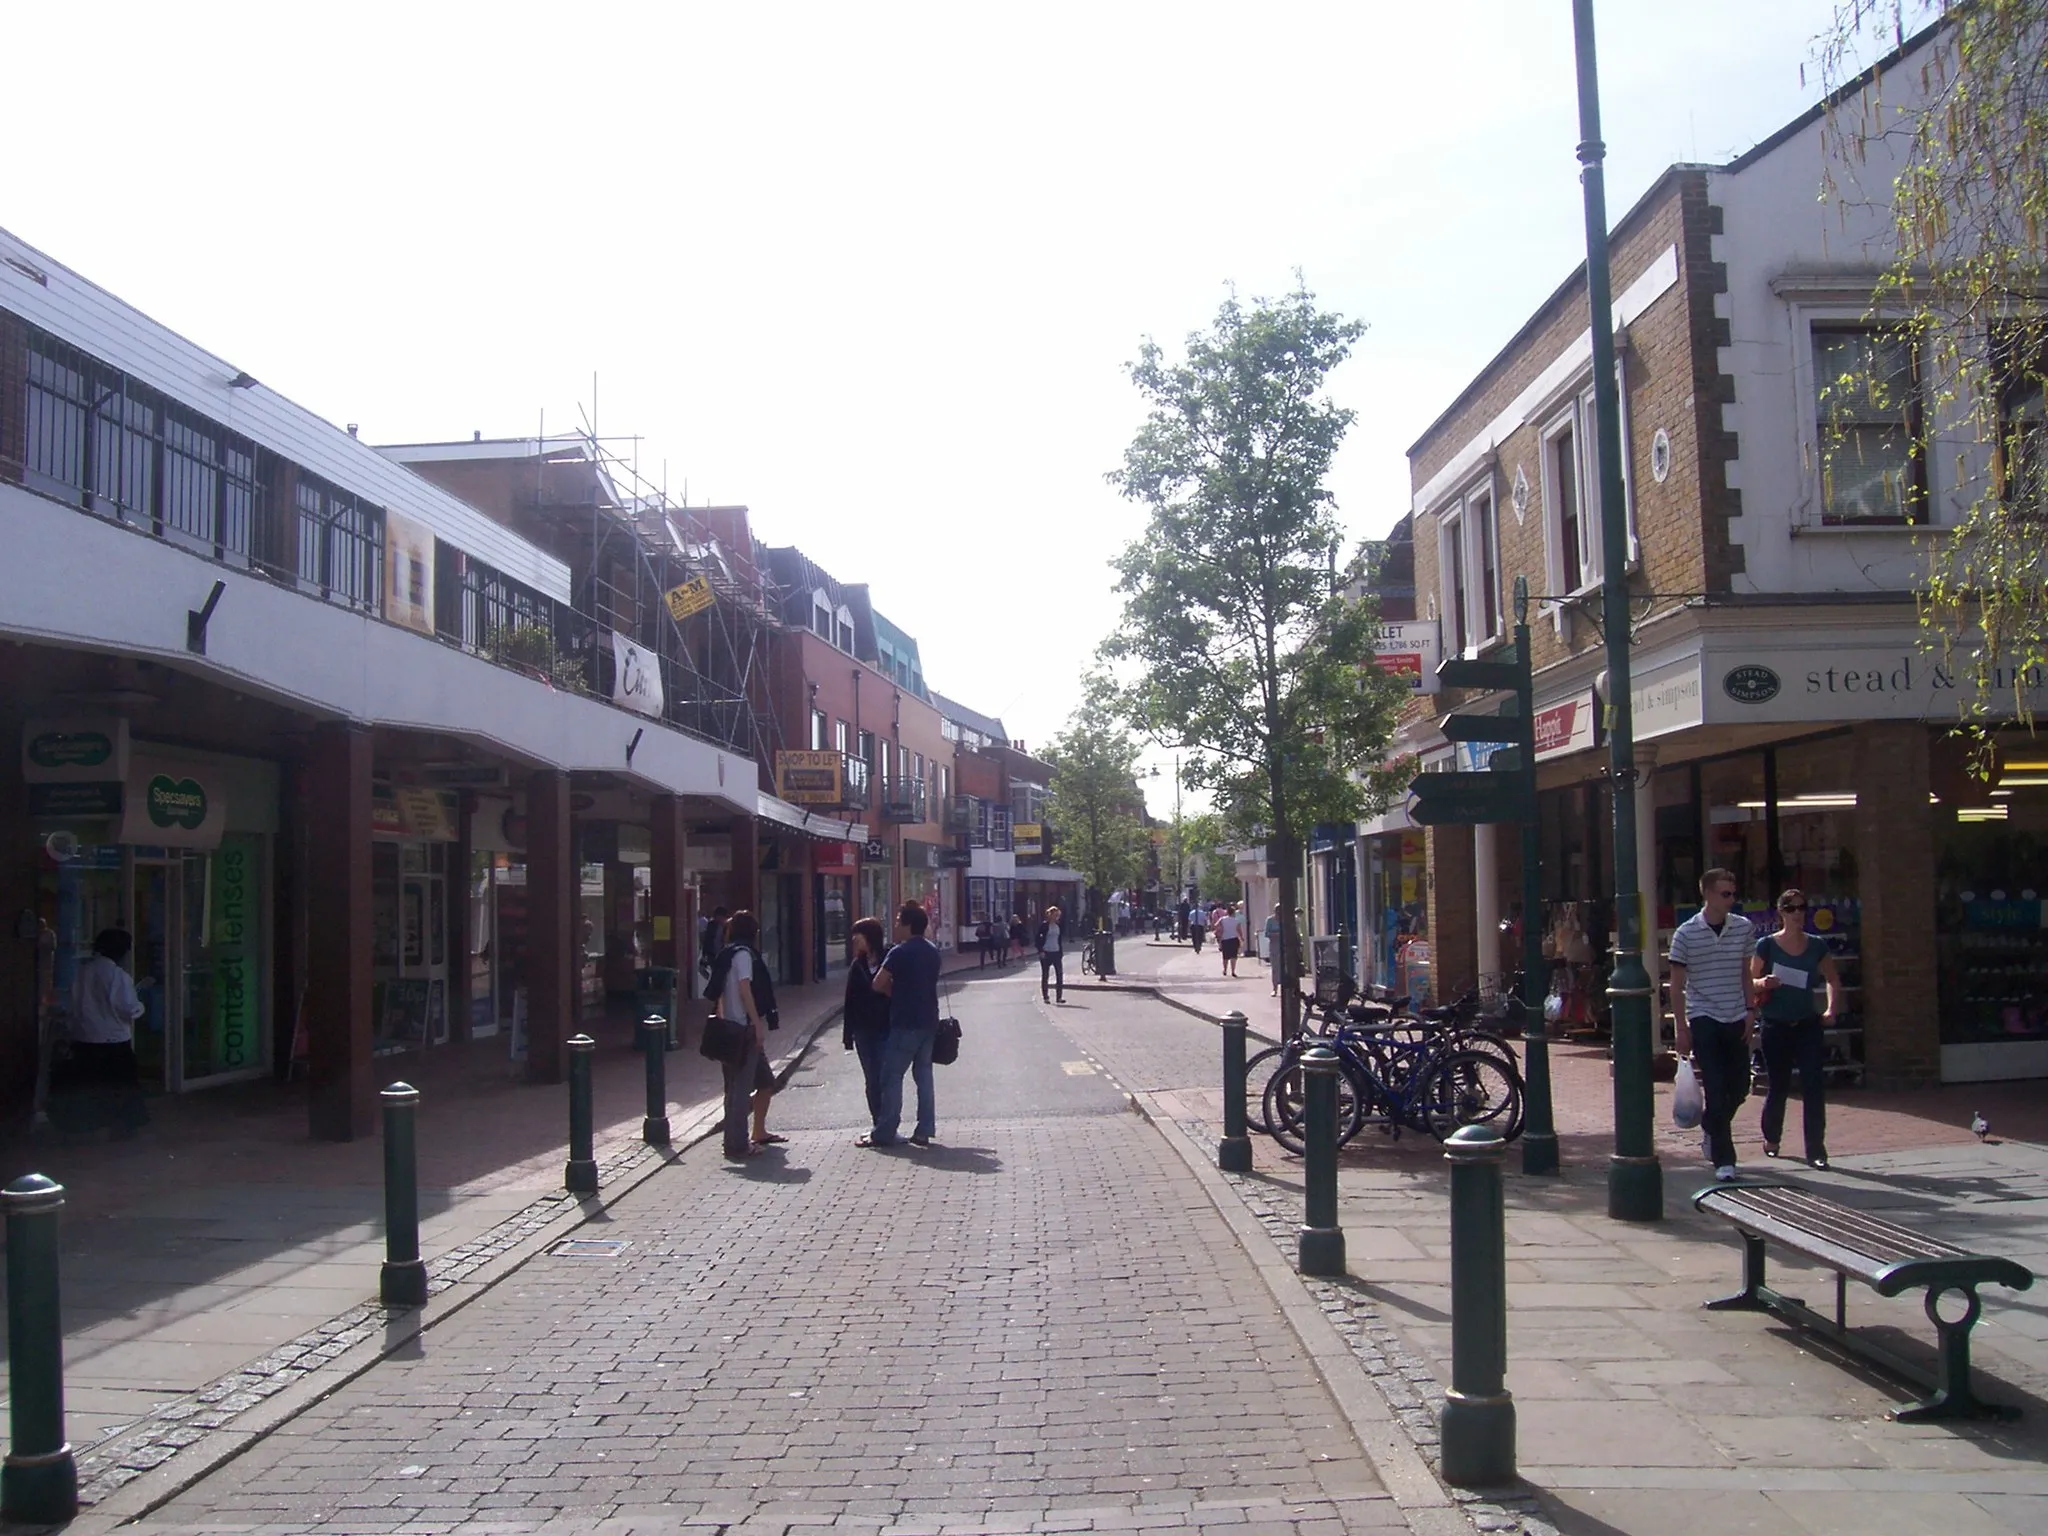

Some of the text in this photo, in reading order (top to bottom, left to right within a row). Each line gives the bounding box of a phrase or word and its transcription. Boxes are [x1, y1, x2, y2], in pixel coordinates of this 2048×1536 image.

[1382, 625, 1404, 639] LET
[1735, 669, 1768, 679] STEAD
[1806, 656, 1913, 693] stead
[1932, 660, 1956, 689] &
[1657, 679, 1699, 711] simpson
[1730, 686, 1776, 698] SIMPSON
[778, 753, 840, 767] SHOP TO LET
[152, 786, 202, 808] Specsavers
[219, 849, 244, 1067] contact lenses
